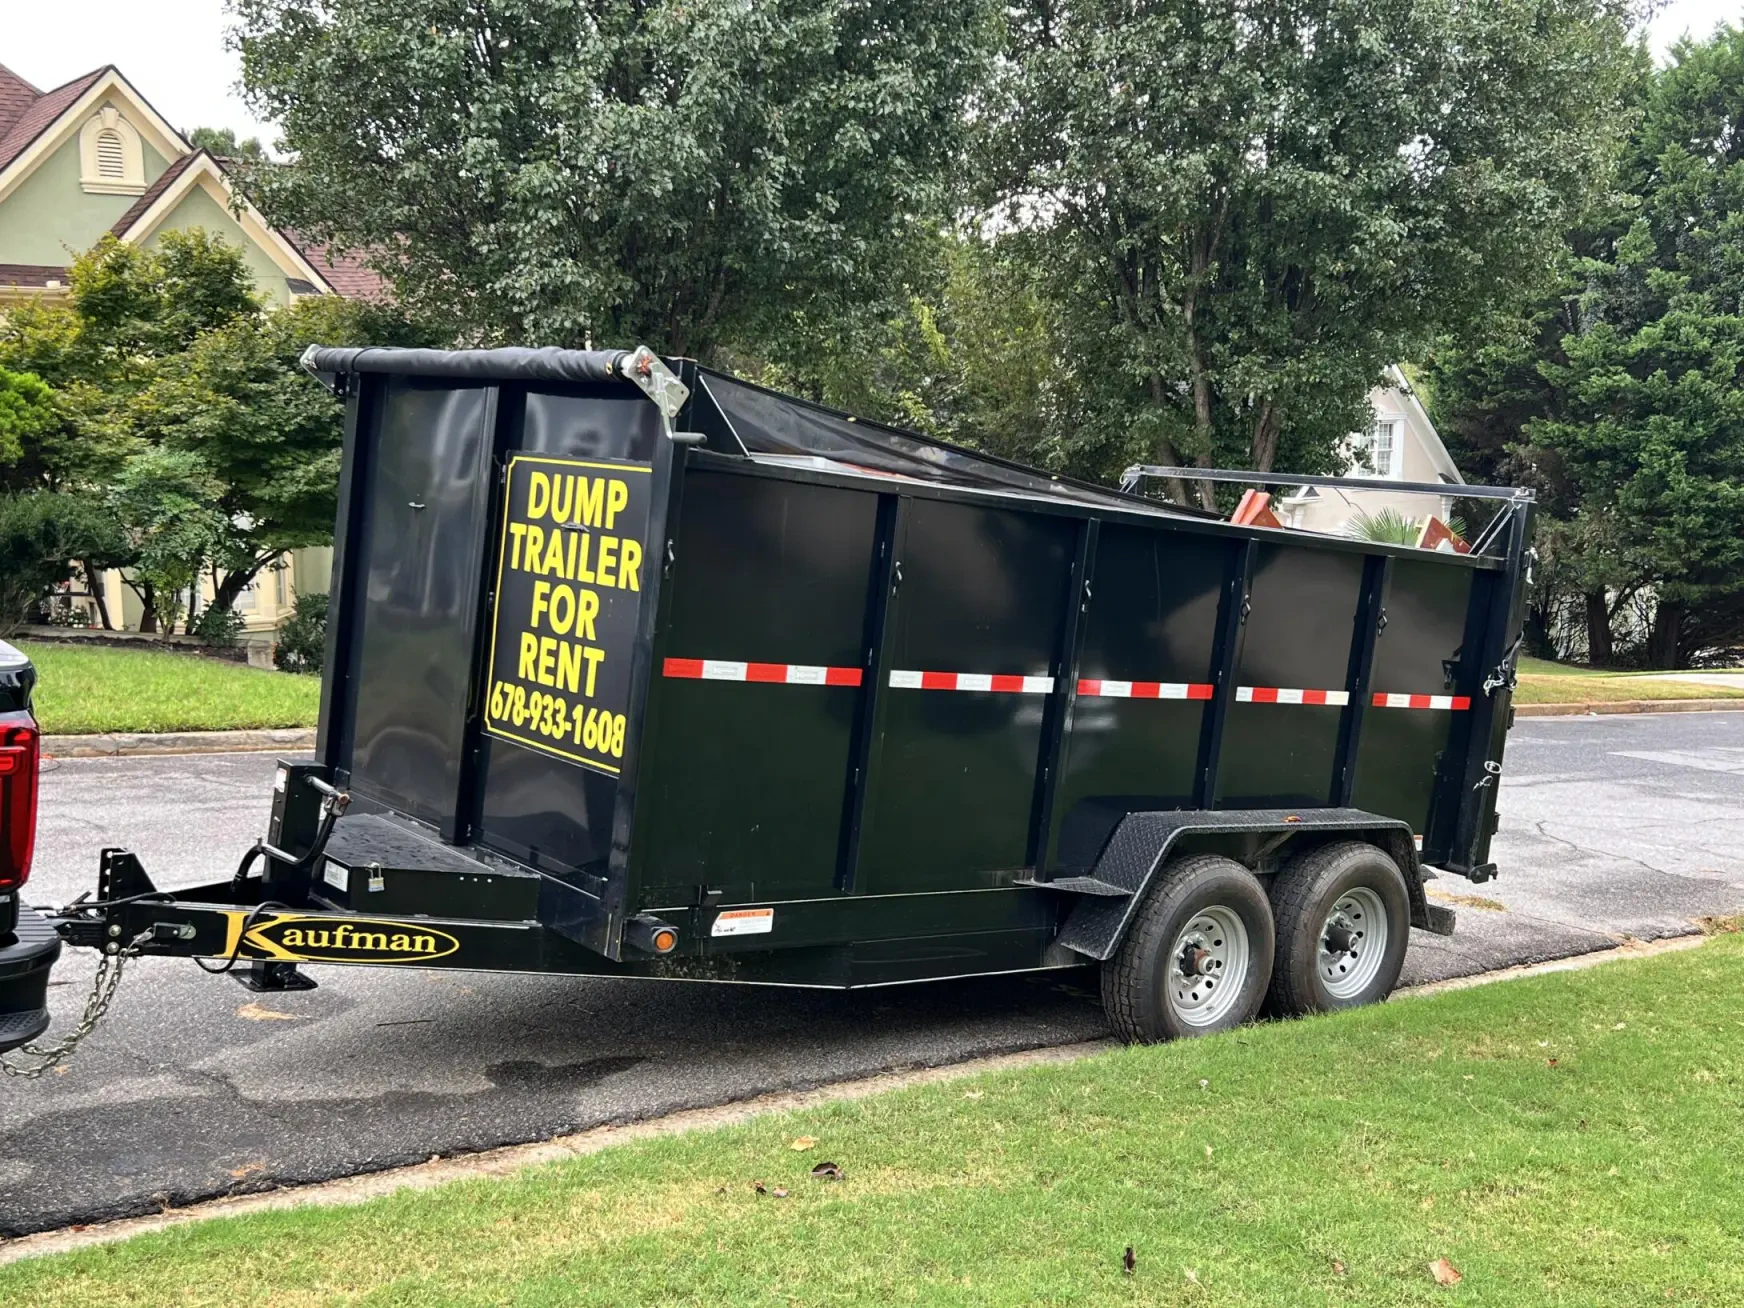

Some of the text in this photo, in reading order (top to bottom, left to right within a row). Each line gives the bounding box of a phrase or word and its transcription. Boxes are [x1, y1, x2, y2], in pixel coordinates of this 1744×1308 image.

[528, 472, 628, 530] DUMP
[510, 522, 642, 592] TRAILER
[531, 581, 600, 640] FOR
[518, 632, 605, 697] RENT
[490, 681, 626, 758] 678-933-1608
[213, 910, 437, 961] Kaufman
